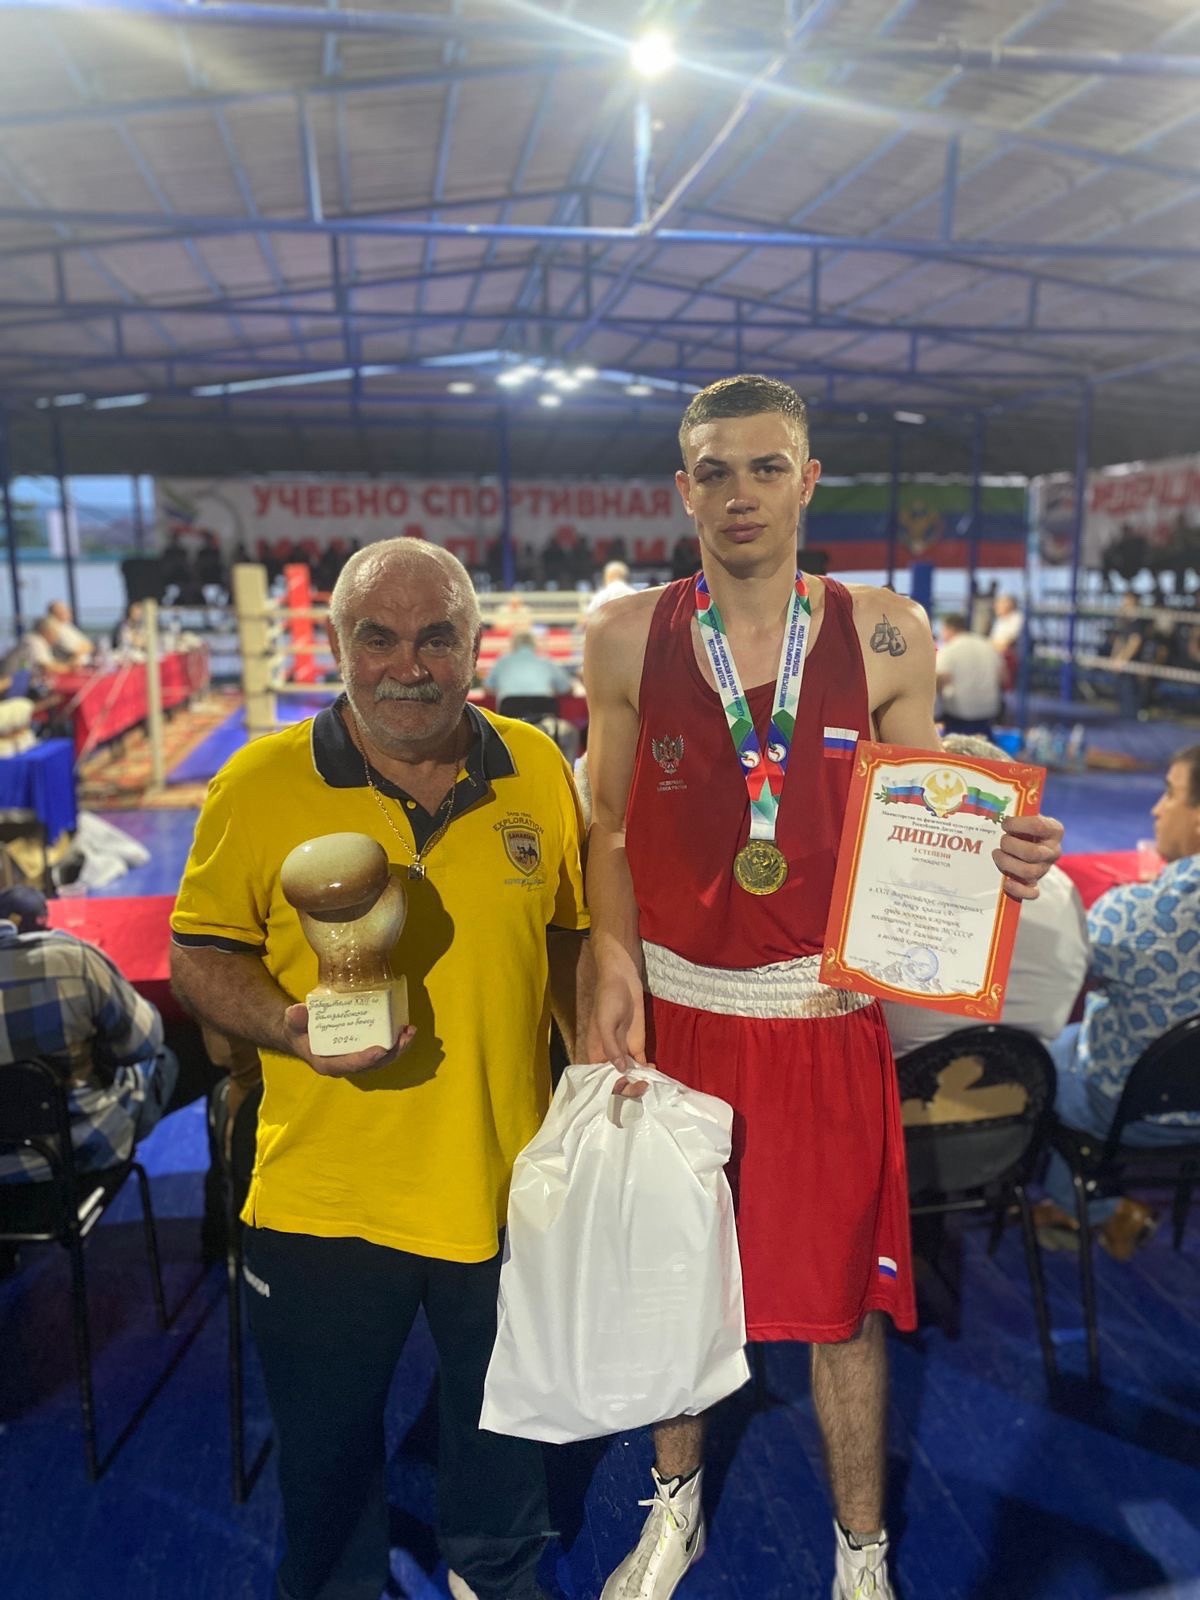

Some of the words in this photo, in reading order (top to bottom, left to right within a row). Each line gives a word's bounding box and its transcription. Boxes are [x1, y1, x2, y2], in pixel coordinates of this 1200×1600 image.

[253, 484, 414, 518] УЧЕБНО
[790, 614, 799, 636] КУЛЬТУРЕ
[796, 625, 805, 648] ДАГЕСТАН
[708, 639, 720, 667] РЕСПУБЛИКИ
[716, 666, 728, 689] ДАГЕСТАН
[786, 636, 795, 666] ФИЗИЧЕСКОЙ
[792, 648, 801, 677] РЕСПУБЛИКИ
[728, 674, 739, 696] КУЛЬТУРЕ
[778, 673, 790, 708] МИНИСТЕРСТВО
[492, 816, 544, 835] EXPLORATION
[887, 825, 983, 854] ДИПЛОМ
[918, 849, 951, 859] СТЕПЕНИ
